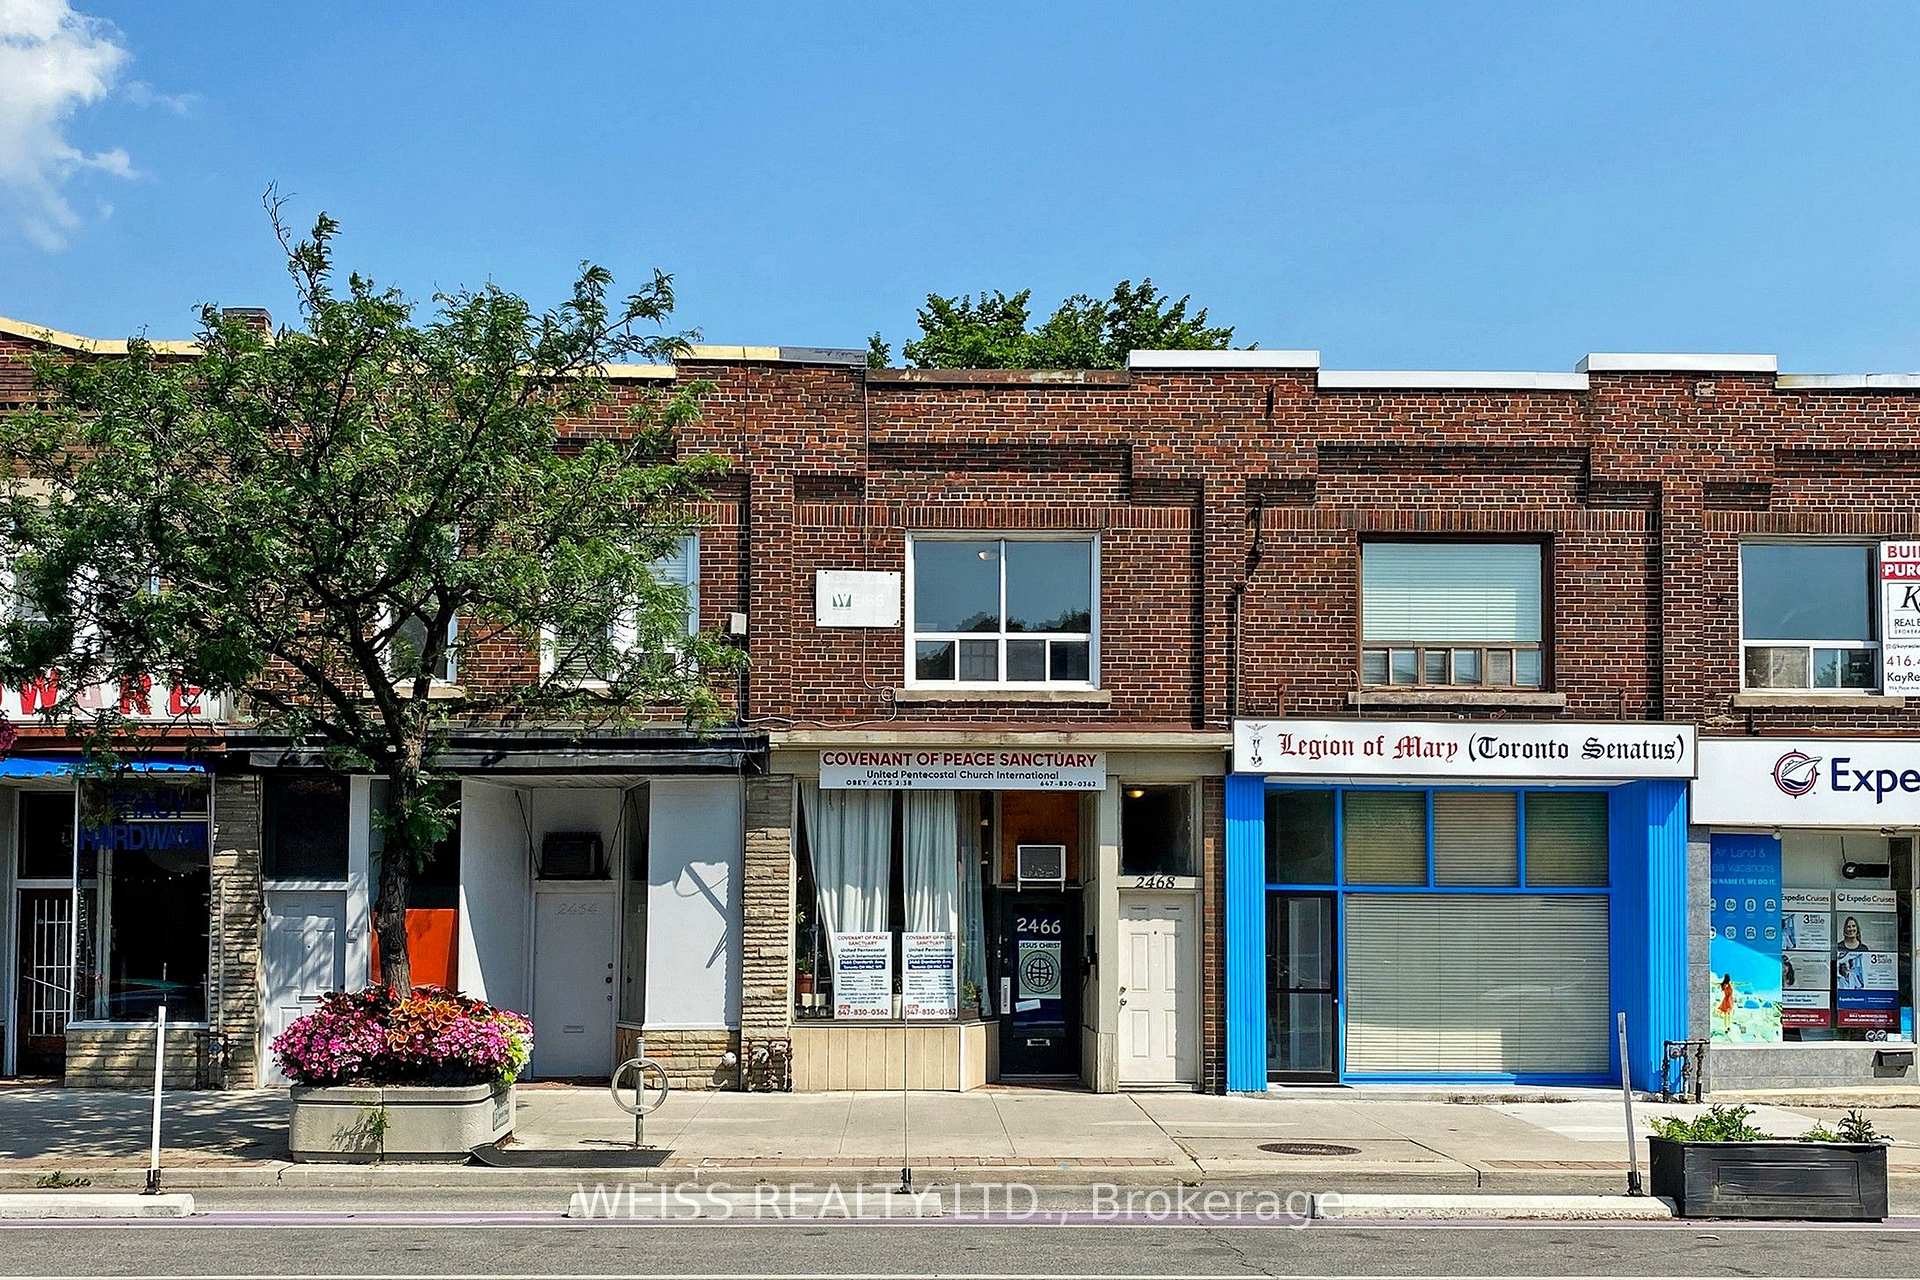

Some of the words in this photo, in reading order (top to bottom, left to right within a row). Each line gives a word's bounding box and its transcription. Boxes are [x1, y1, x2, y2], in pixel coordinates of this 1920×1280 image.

[1894, 618, 1917, 627] REAL
[1278, 733, 1354, 760] Legion
[1363, 735, 1385, 756] of
[1392, 735, 1458, 763] Mary
[1468, 732, 1569, 762] (Toronto
[1581, 733, 1684, 764] Senatus)
[822, 752, 912, 767] COVENANT
[916, 752, 938, 766] OF
[943, 753, 995, 767] PEACE
[999, 752, 1098, 768] SANCTUARY
[866, 770, 898, 779] United
[901, 770, 957, 779] Pentecostal
[959, 771, 994, 779] Church
[996, 770, 1059, 780] International
[1831, 757, 1920, 804] Expe
[1134, 875, 1176, 890] 2468
[1805, 894, 1829, 902] Cruises
[1846, 895, 1871, 903] Expedia
[1871, 895, 1895, 903] Cruises
[1803, 914, 1810, 924] 3
[1016, 918, 1062, 935] 2466
[837, 1008, 888, 1016] 647-830-0362
